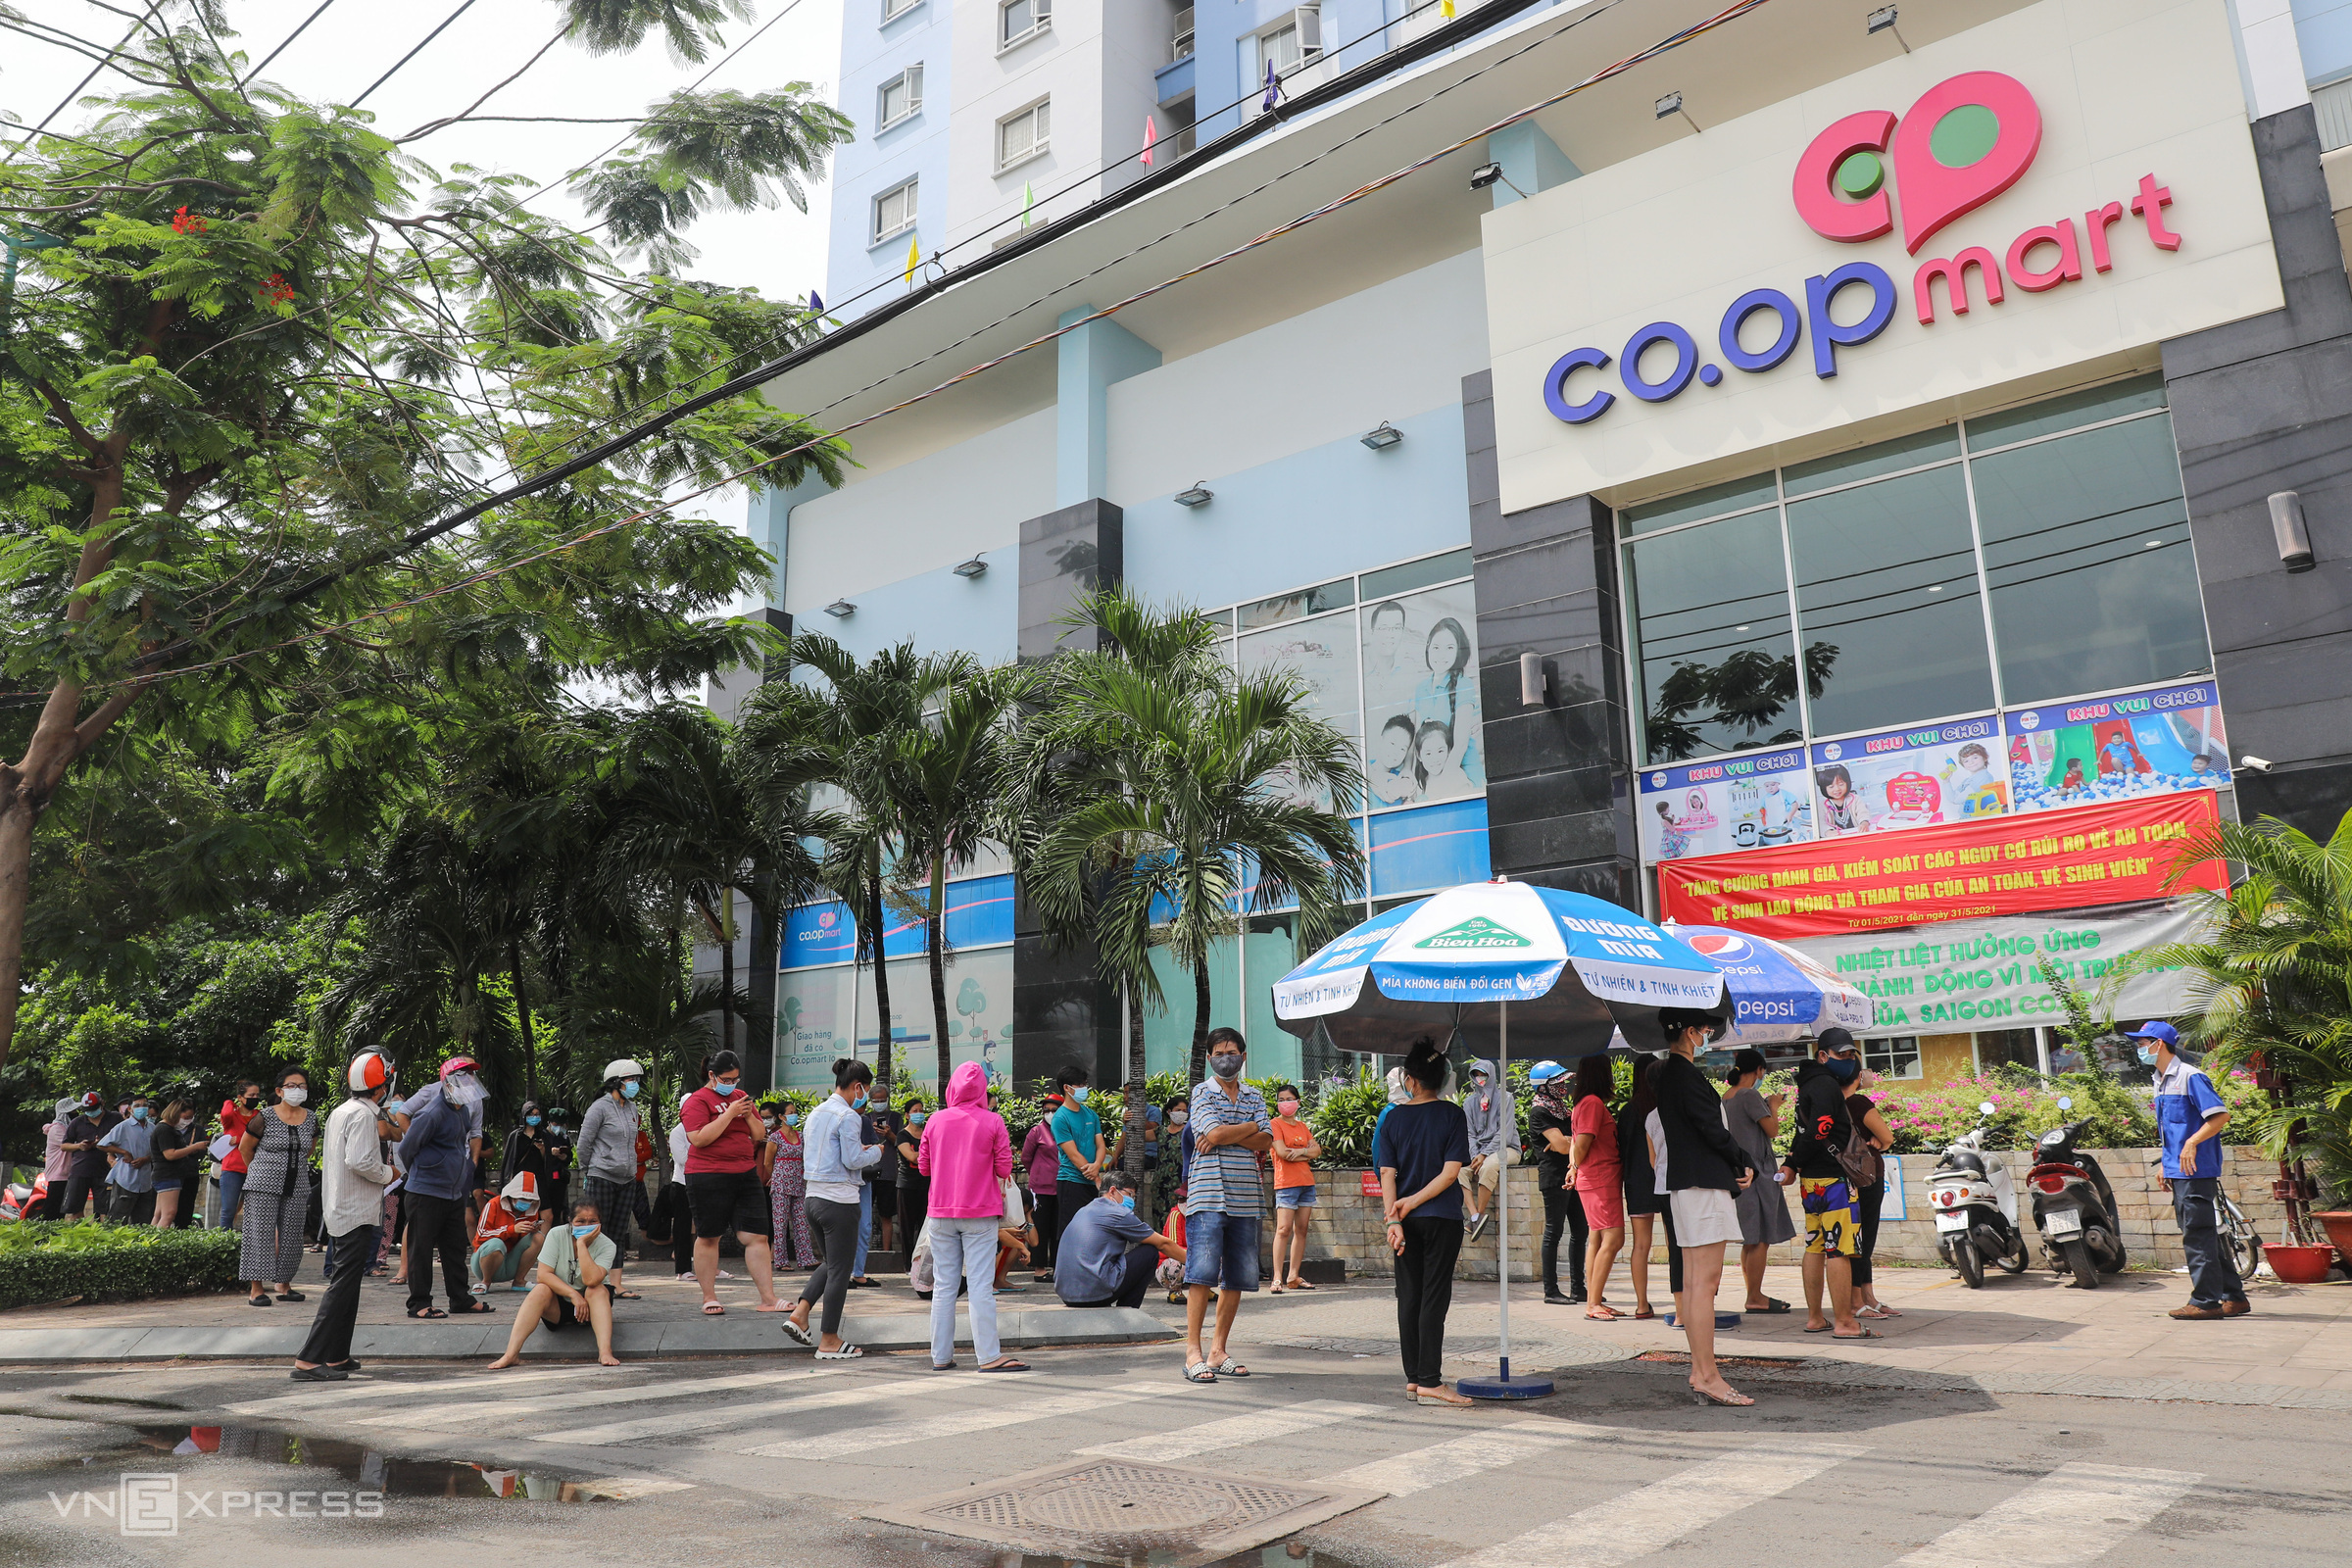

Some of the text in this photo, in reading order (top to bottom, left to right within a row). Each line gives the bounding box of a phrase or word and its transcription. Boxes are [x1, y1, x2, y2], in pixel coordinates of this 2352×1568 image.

[2067, 688, 2207, 722] KHU VUI CHƠI
[1866, 721, 1989, 753] KHU VUI CHƠI
[1689, 765, 1722, 782] KHU
[1726, 760, 1753, 775] VUI
[1756, 754, 1798, 771] CHƠI
[1723, 872, 1769, 894] CƯỜNG
[1772, 866, 1809, 888] ĐÁNH
[1814, 863, 1840, 883] GIÁ,
[1843, 856, 1879, 878] KIỂM
[1883, 854, 1921, 874] SOÁT
[1924, 848, 1955, 869] CÁC
[1958, 845, 2000, 864] NGUY
[2004, 839, 2027, 859] CƠ
[2031, 835, 2058, 857] RỦI
[2062, 834, 2085, 853] RO
[2088, 826, 2111, 850] VỀ
[2114, 827, 2137, 847] AN
[1712, 904, 1729, 923] VỆ
[1732, 902, 1764, 921] SINH
[1767, 899, 1790, 916] LAO
[1794, 894, 1834, 915] ĐỘNG
[1836, 890, 1857, 908] VÀ
[1858, 886, 1901, 907] THAM
[1904, 883, 1930, 902] GIA
[1934, 876, 1965, 898] CỦA
[1968, 874, 1989, 894] AN
[1992, 868, 2038, 891] TOÀN,
[2040, 864, 2062, 888] VỆ
[2066, 863, 2105, 883] SINH
[1848, 905, 1996, 928] Từ 01/5/2021 đến ngày 31/5/2021
[1836, 927, 2101, 973] NHIỆT LIỆT HƯỞNG ỨNG
[1382, 974, 1512, 989] MÍA KHÔNG BIẾN ĐỔI GEN
[1584, 972, 1716, 998] TỰ NHIÊN & TINH KHIẾT
[1925, 967, 1993, 995] ĐỘNG
[1997, 962, 2022, 986] VÌ
[1293, 988, 1313, 1006] NHIÊN
[1323, 986, 1341, 1001] TINH
[1738, 999, 1794, 1019] pepsi
[1874, 1002, 1910, 1026] ỦA
[1921, 998, 2012, 1023] SAIGON
[797, 1032, 812, 1041] Giao
[790, 1054, 827, 1065] Co.opmart
